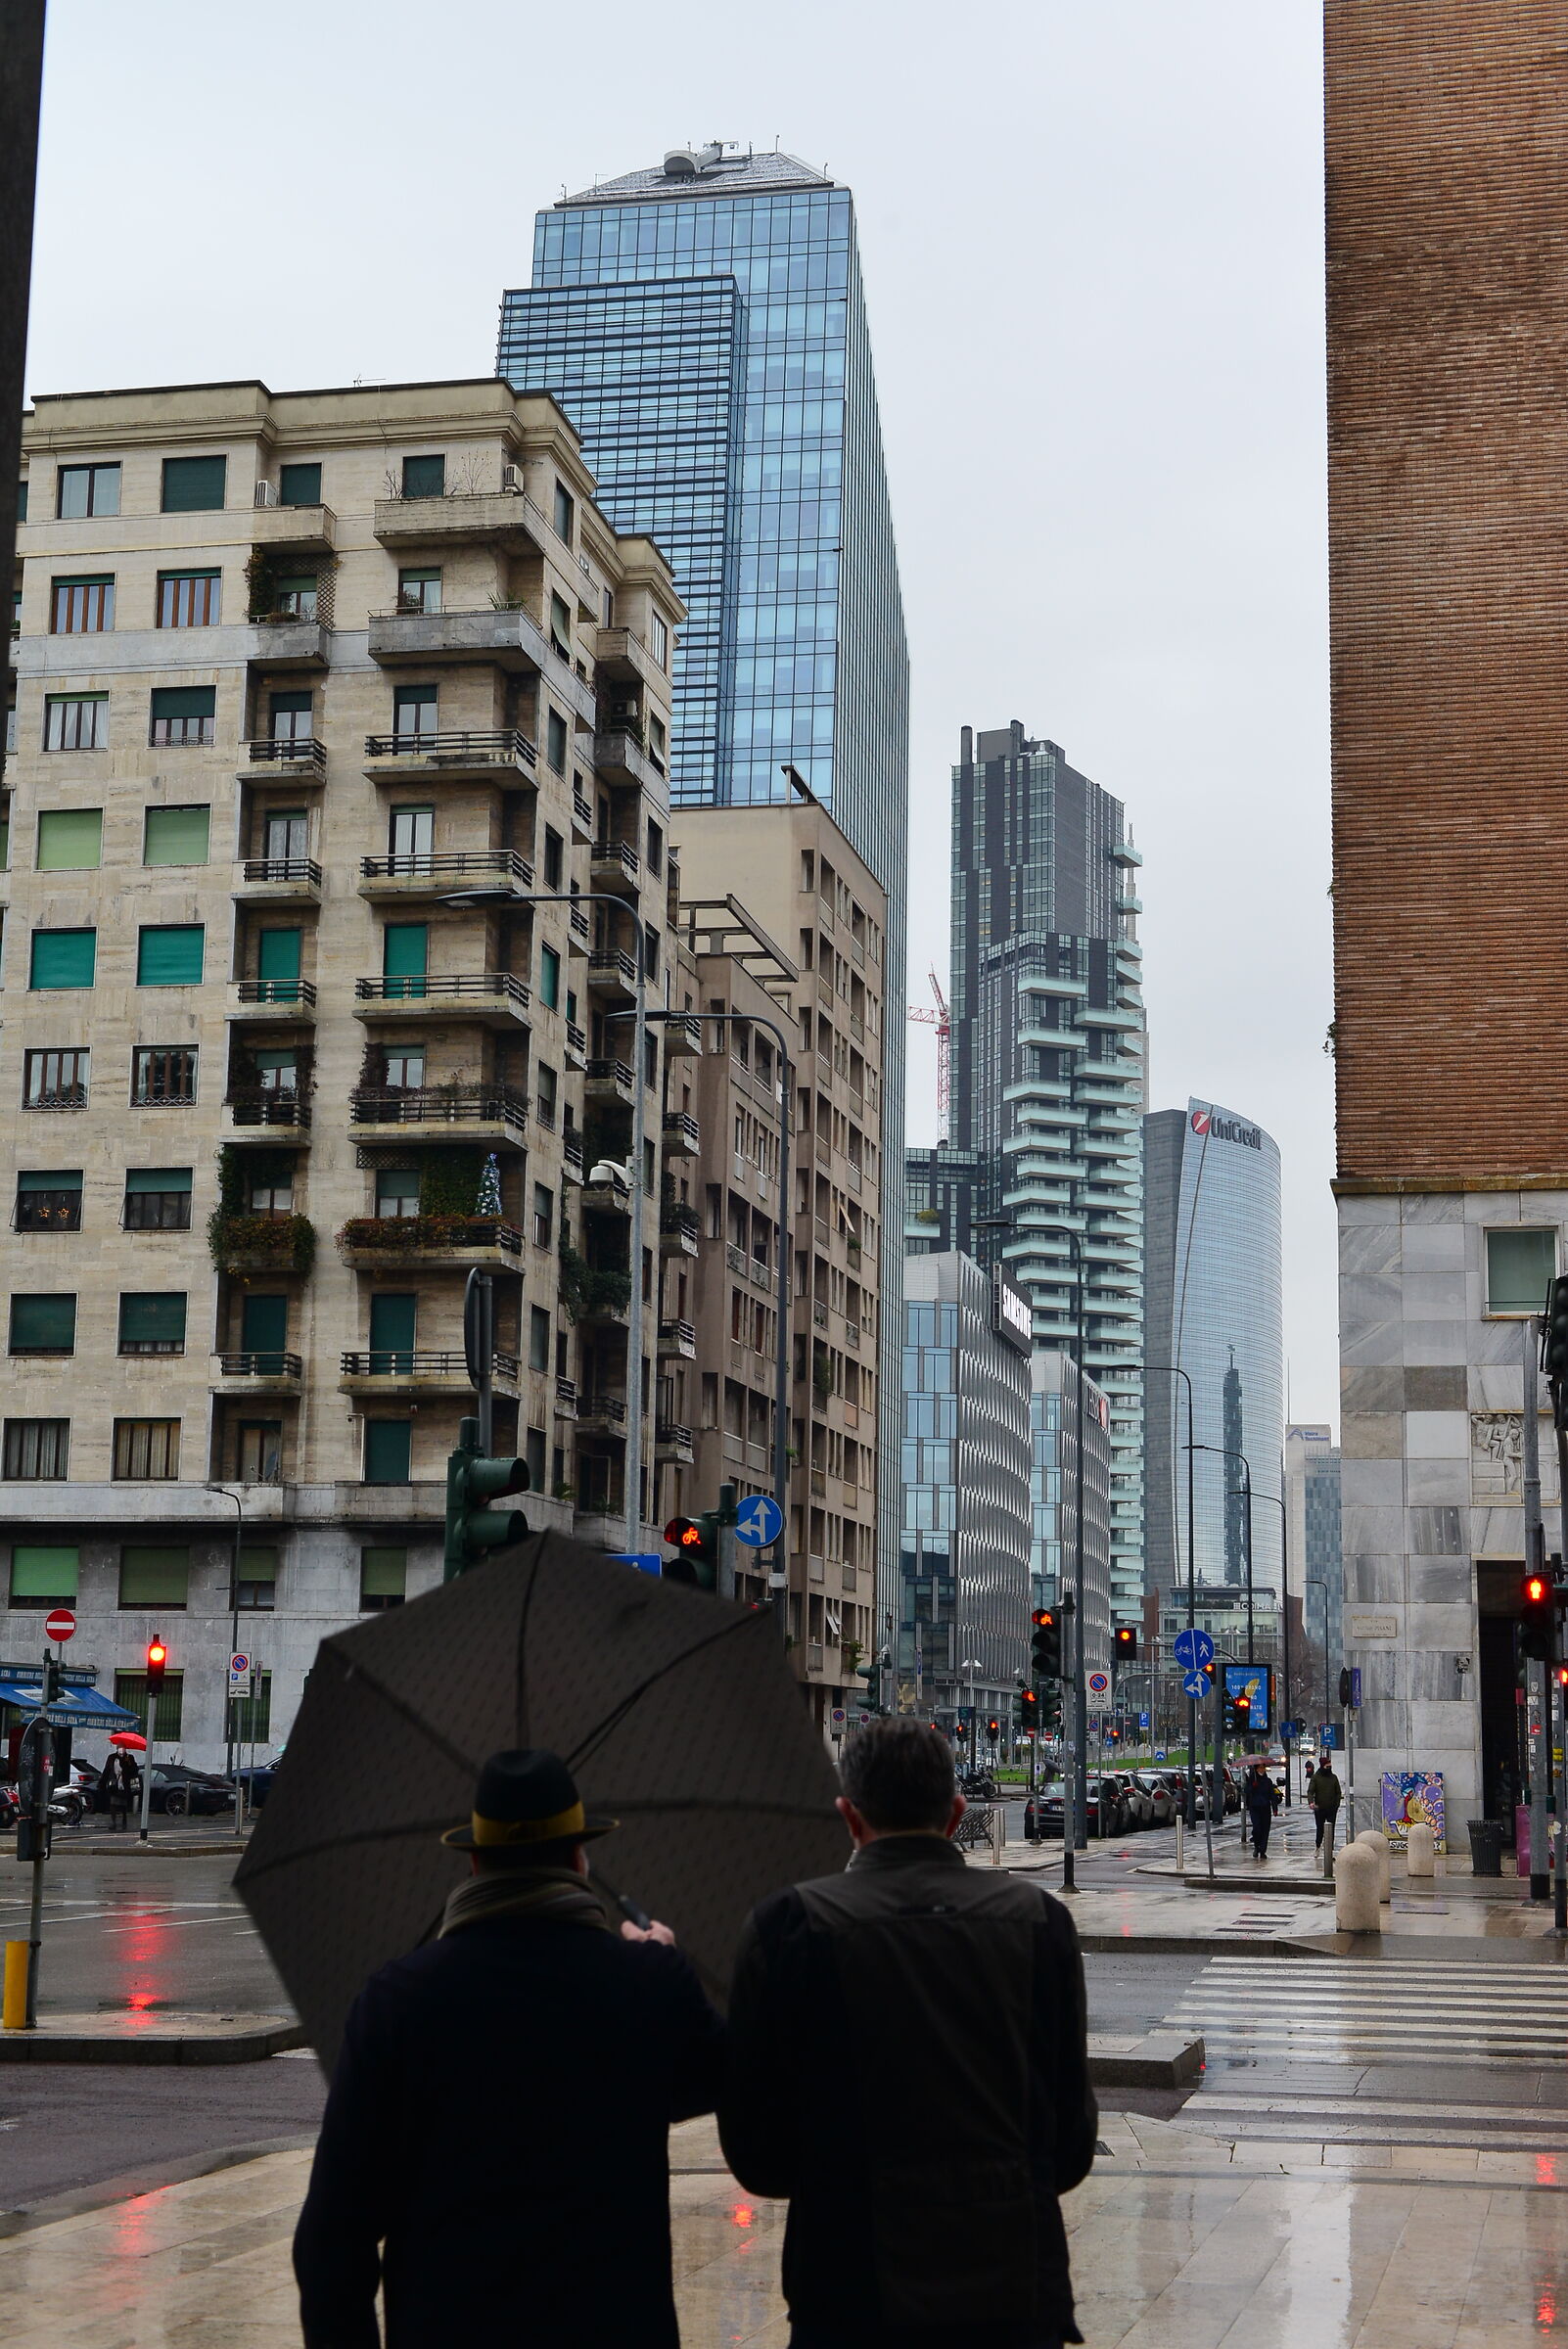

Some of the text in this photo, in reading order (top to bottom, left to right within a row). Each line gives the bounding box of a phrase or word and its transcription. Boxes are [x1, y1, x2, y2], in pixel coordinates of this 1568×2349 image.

[1211, 1117, 1262, 1150] UniCredit
[1002, 1283, 1032, 1341] SAMSUNG
[1324, 1727, 1331, 1736] P
